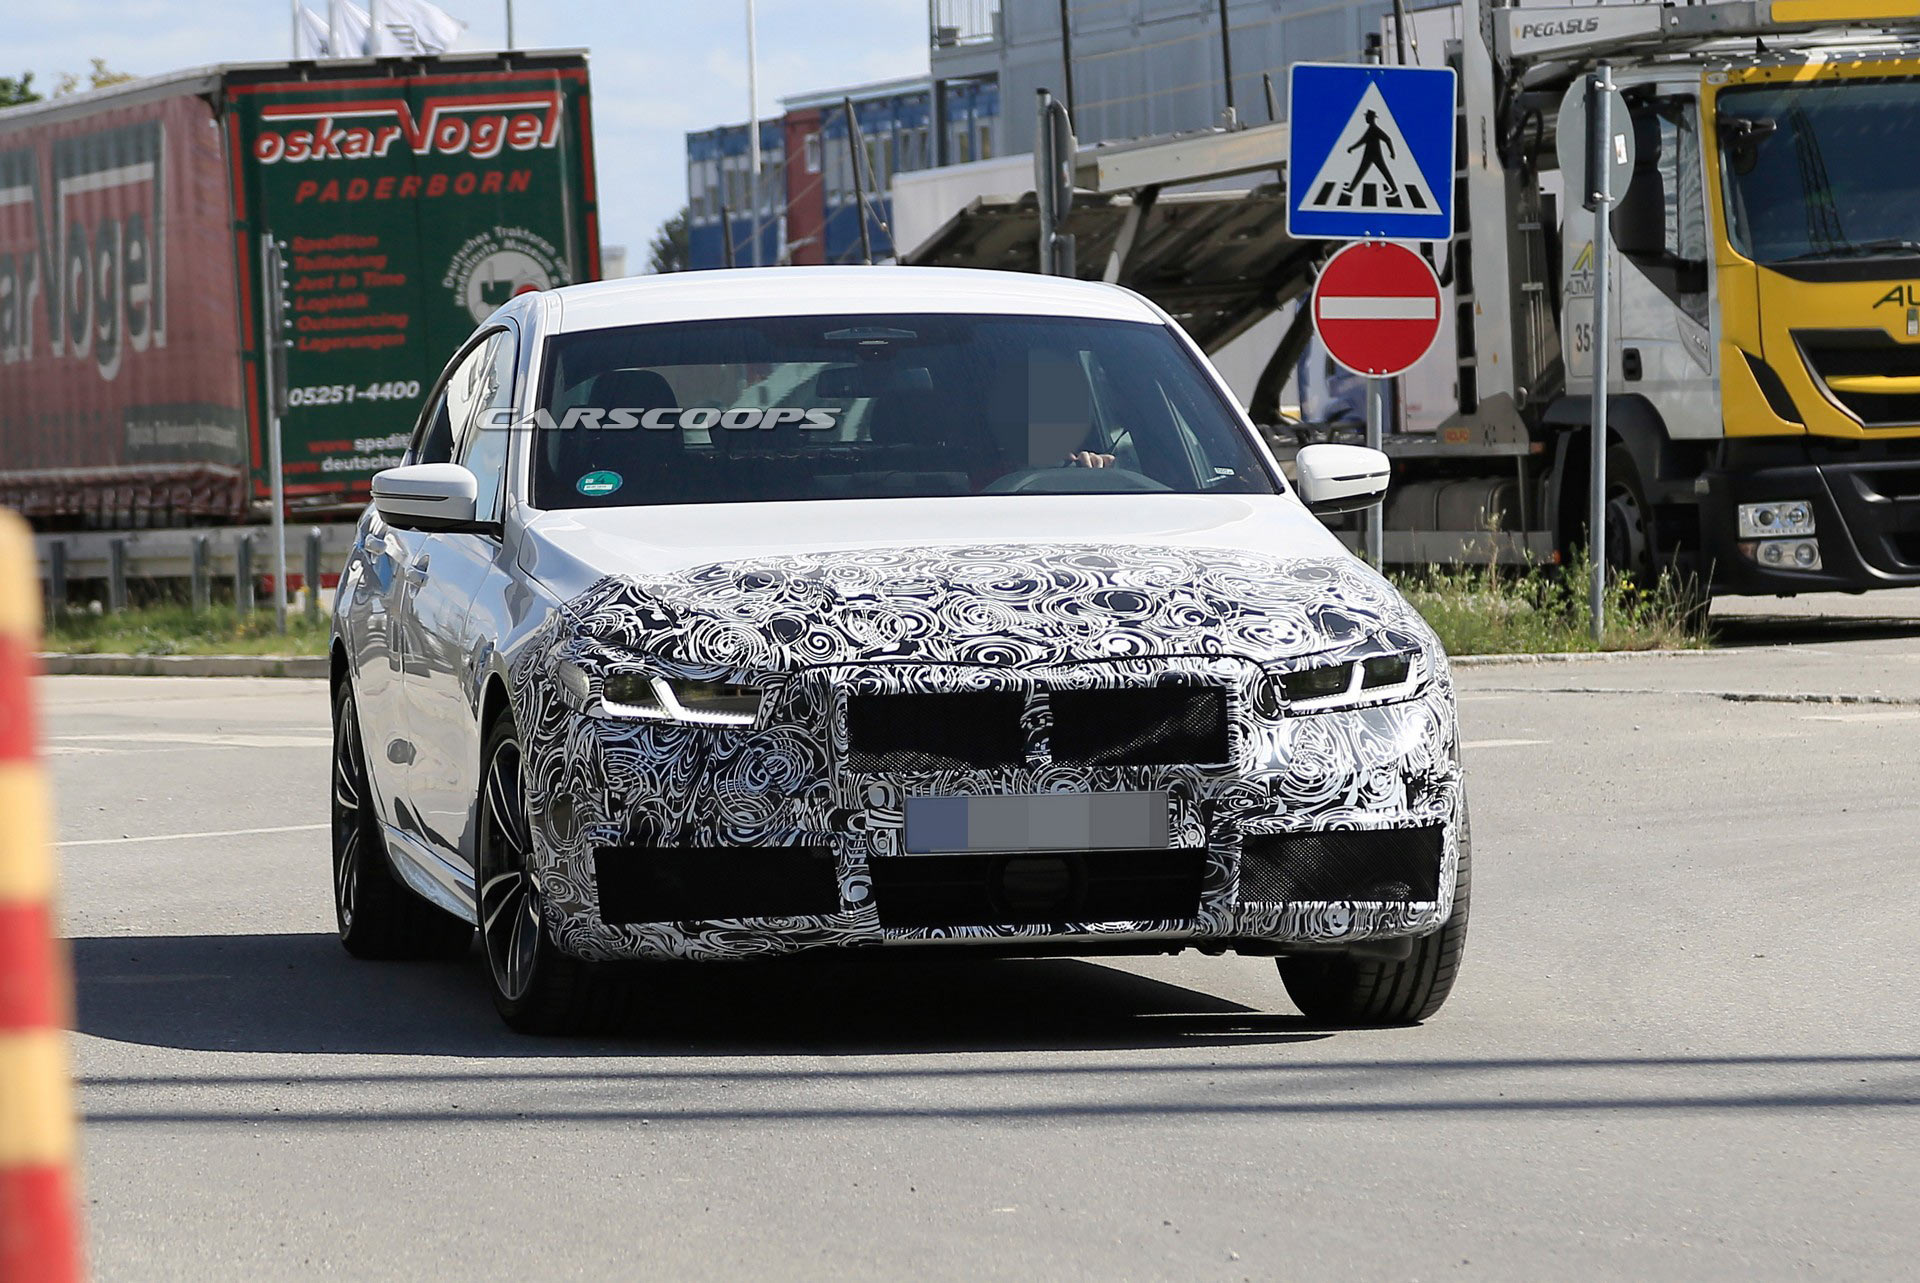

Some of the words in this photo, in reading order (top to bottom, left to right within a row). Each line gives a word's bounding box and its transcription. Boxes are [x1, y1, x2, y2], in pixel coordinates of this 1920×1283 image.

[1521, 17, 1599, 39] PEGASUS
[253, 115, 402, 164] oskar
[396, 90, 564, 160] Vogel
[294, 169, 533, 204] PADERBORN
[33, 120, 168, 382] Vogel
[292, 235, 379, 253] Spedition
[442, 232, 491, 288] Deutsches
[493, 226, 556, 257] Traktoren
[294, 274, 334, 290] Just
[338, 273, 357, 288] in
[363, 271, 406, 287] Time
[455, 243, 499, 306] Modellauto
[502, 239, 554, 273] Museum
[295, 293, 368, 312] Logistik
[296, 313, 408, 331] Outsourcing
[288, 380, 420, 406] 05251-4400
